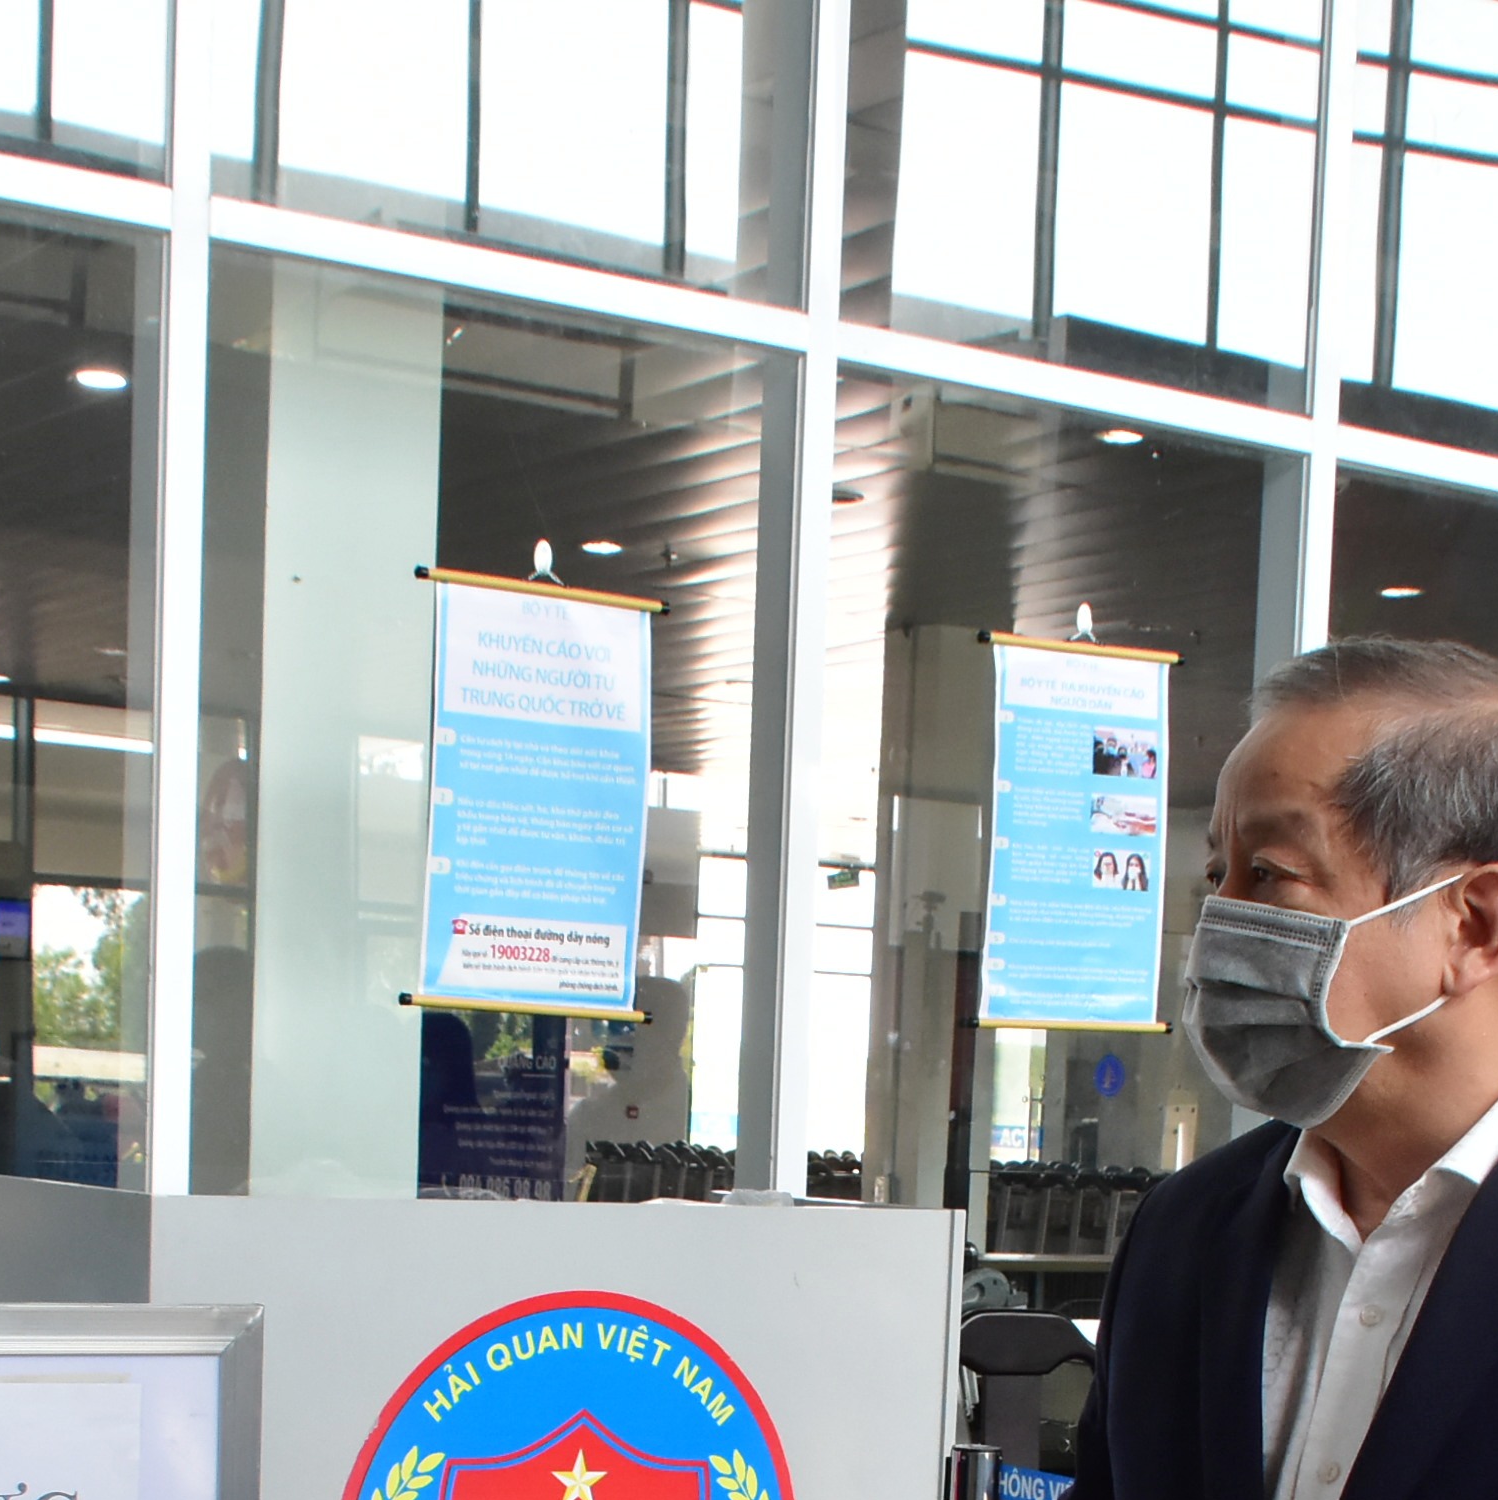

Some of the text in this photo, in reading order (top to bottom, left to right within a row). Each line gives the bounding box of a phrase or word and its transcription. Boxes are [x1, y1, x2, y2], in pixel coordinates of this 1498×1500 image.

[546, 637, 582, 661] CÁO
[536, 667, 591, 689] NGƯỜI
[461, 687, 516, 709] TRUNG
[518, 693, 565, 715] QUỐC
[469, 922, 481, 936] Số
[483, 923, 504, 941] điện
[506, 925, 532, 942] thoại
[533, 927, 564, 945] đường
[585, 932, 611, 949] nóng
[489, 943, 551, 963] 19003228
[423, 1322, 736, 1427] HẢI QUAN VIỆT NAM
